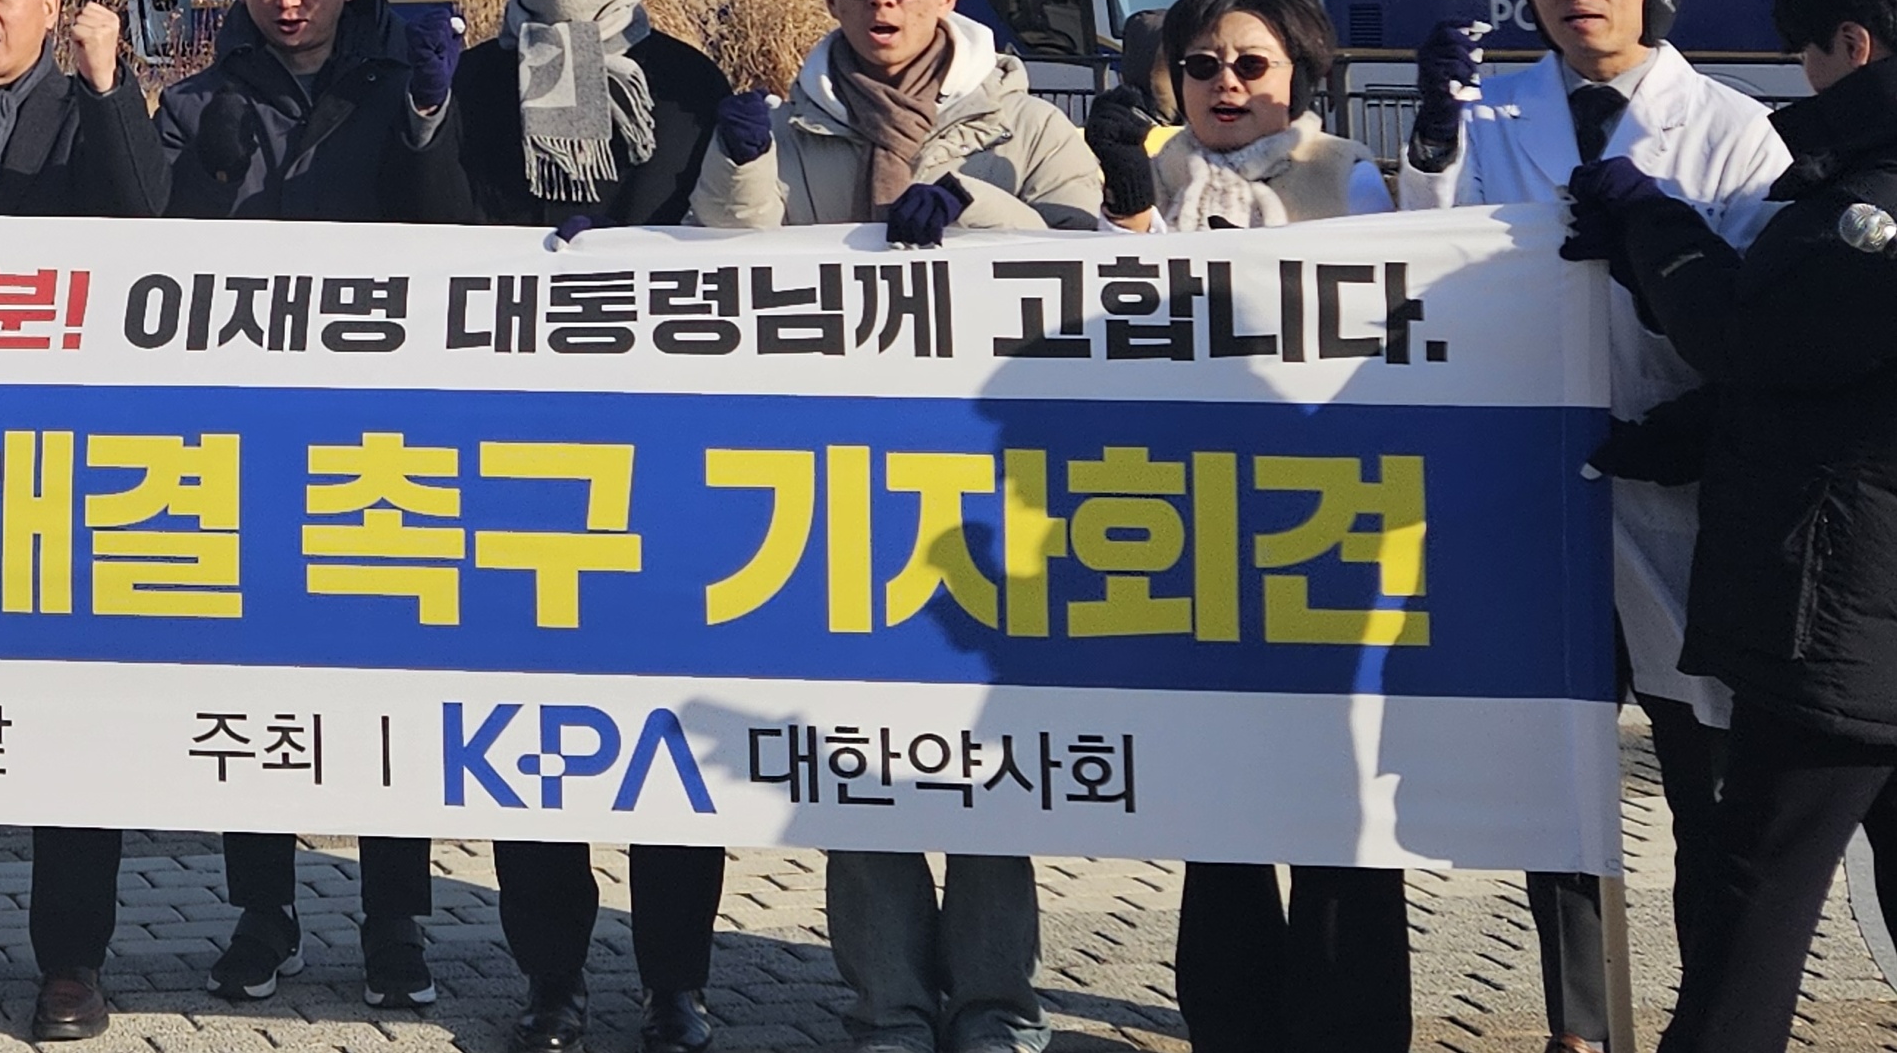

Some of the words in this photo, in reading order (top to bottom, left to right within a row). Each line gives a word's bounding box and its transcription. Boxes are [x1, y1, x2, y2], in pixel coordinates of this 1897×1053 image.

[125, 274, 409, 352] 이재명
[447, 261, 952, 357] 대통령님께
[993, 257, 1447, 364] 고합니다.
[303, 433, 640, 627] 촉구
[707, 445, 1428, 644] 기자회견
[189, 713, 321, 784] 주최
[749, 725, 1135, 813] 대한약사회
